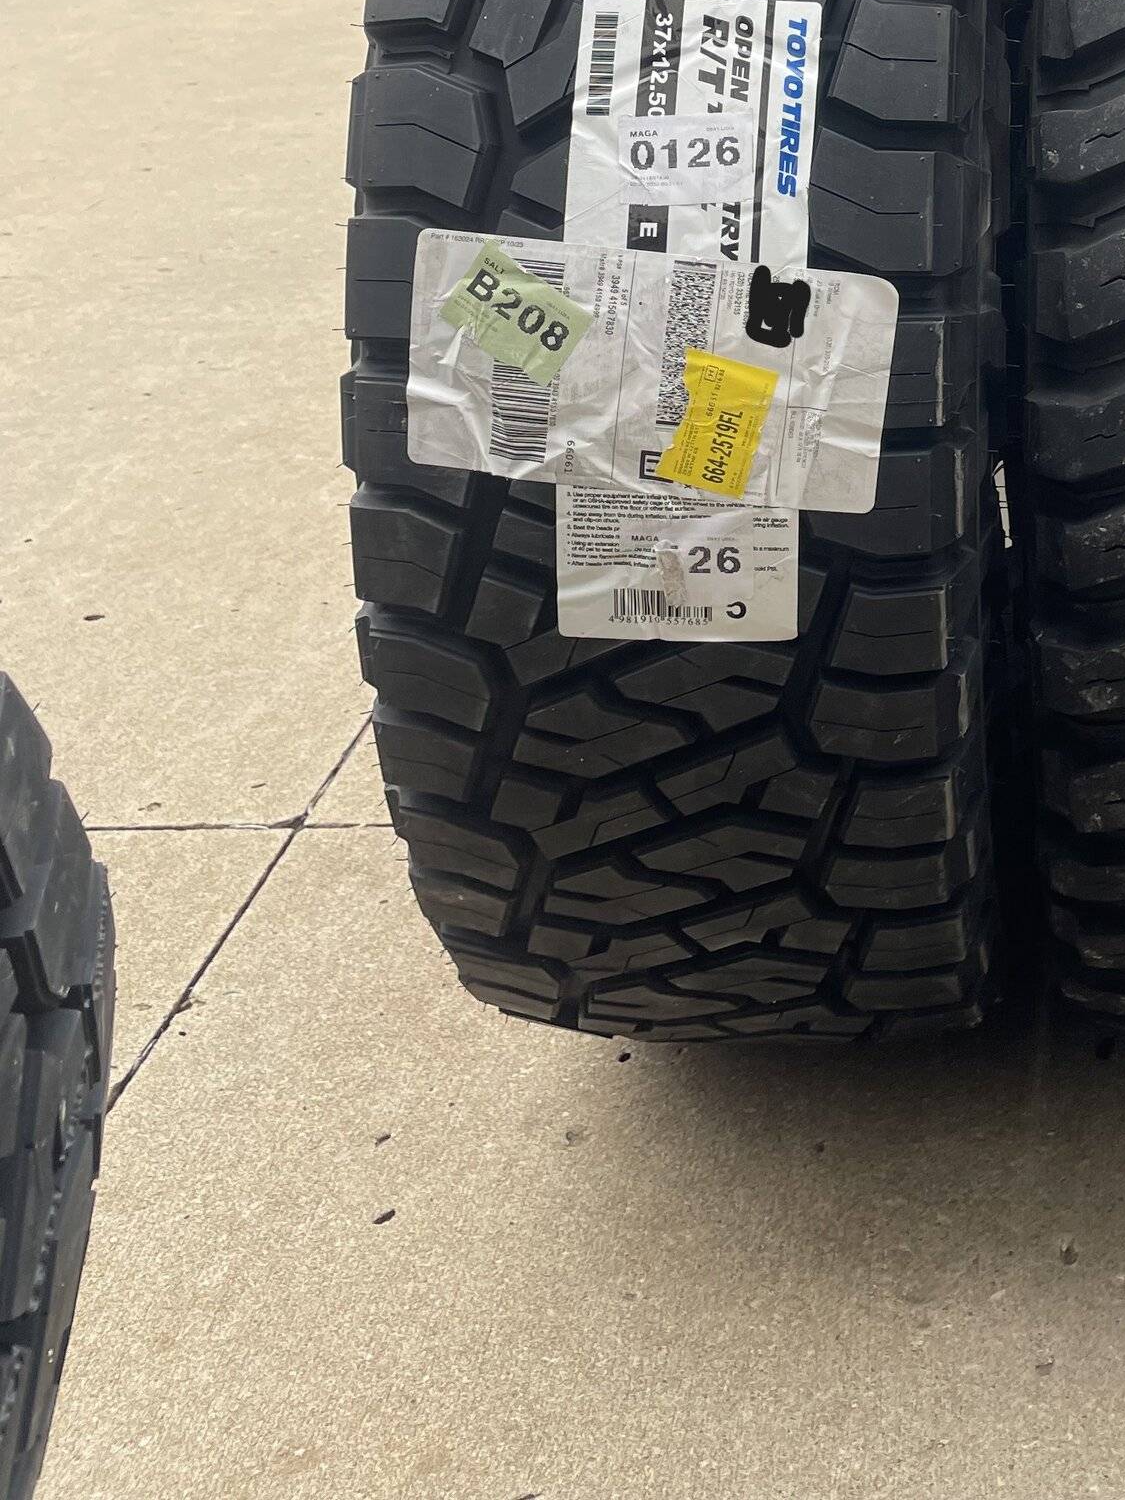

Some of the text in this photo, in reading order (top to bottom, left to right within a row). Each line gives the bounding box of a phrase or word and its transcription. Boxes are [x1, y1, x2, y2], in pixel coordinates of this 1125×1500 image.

[698, 14, 730, 95] R/T
[730, 15, 754, 102] OPEN
[776, 18, 808, 198] TOYO TIRES
[630, 130, 658, 138] MAGA
[630, 136, 741, 170] 0126
[430, 232, 444, 240] Part
[639, 222, 658, 238] E
[484, 257, 505, 275] SALT
[610, 275, 621, 294] 3949
[466, 268, 570, 351] B208
[607, 296, 618, 315] 4150
[605, 317, 616, 336] 7830
[701, 410, 744, 484] 664-2519FL
[564, 440, 576, 474] 66061
[667, 617, 708, 626] 557685
